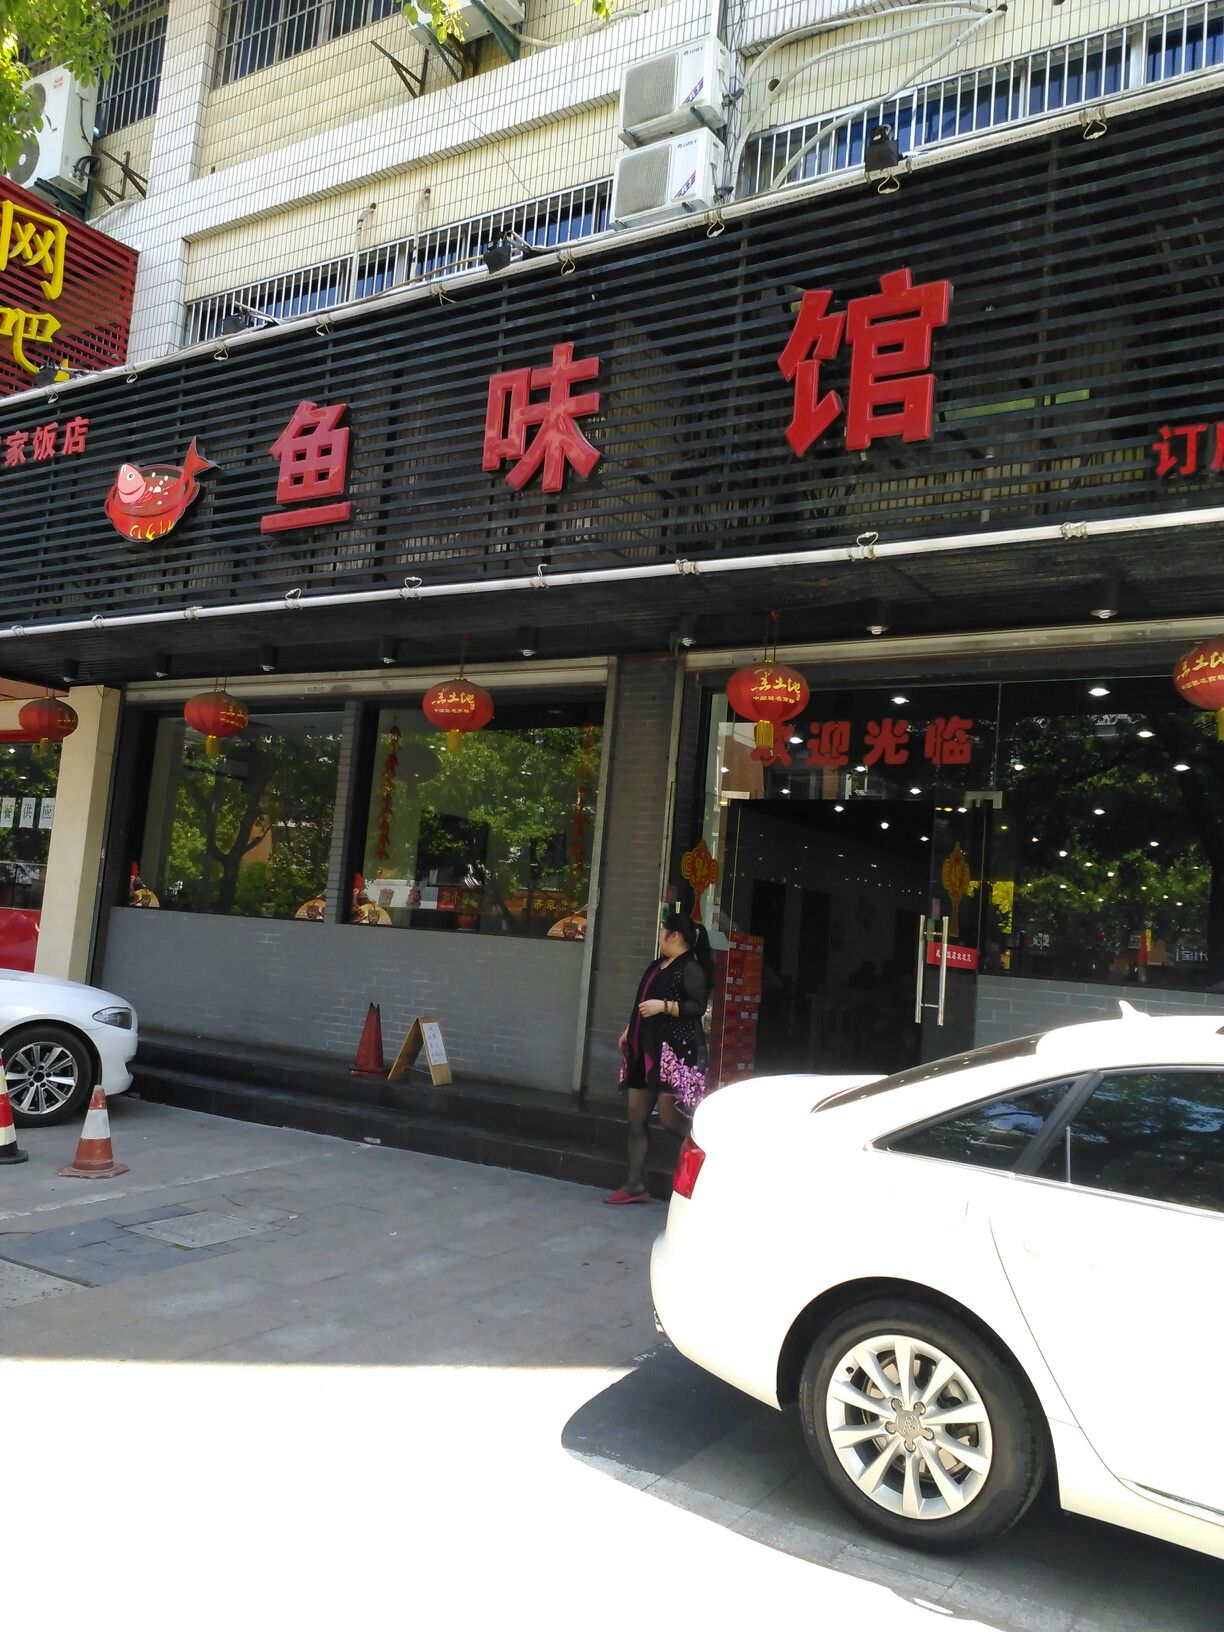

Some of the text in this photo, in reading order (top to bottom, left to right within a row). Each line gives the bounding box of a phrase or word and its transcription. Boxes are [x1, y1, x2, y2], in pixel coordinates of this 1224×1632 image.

[0, 415, 90, 468] 家饭店
[260, 266, 953, 534] 鱼味馆
